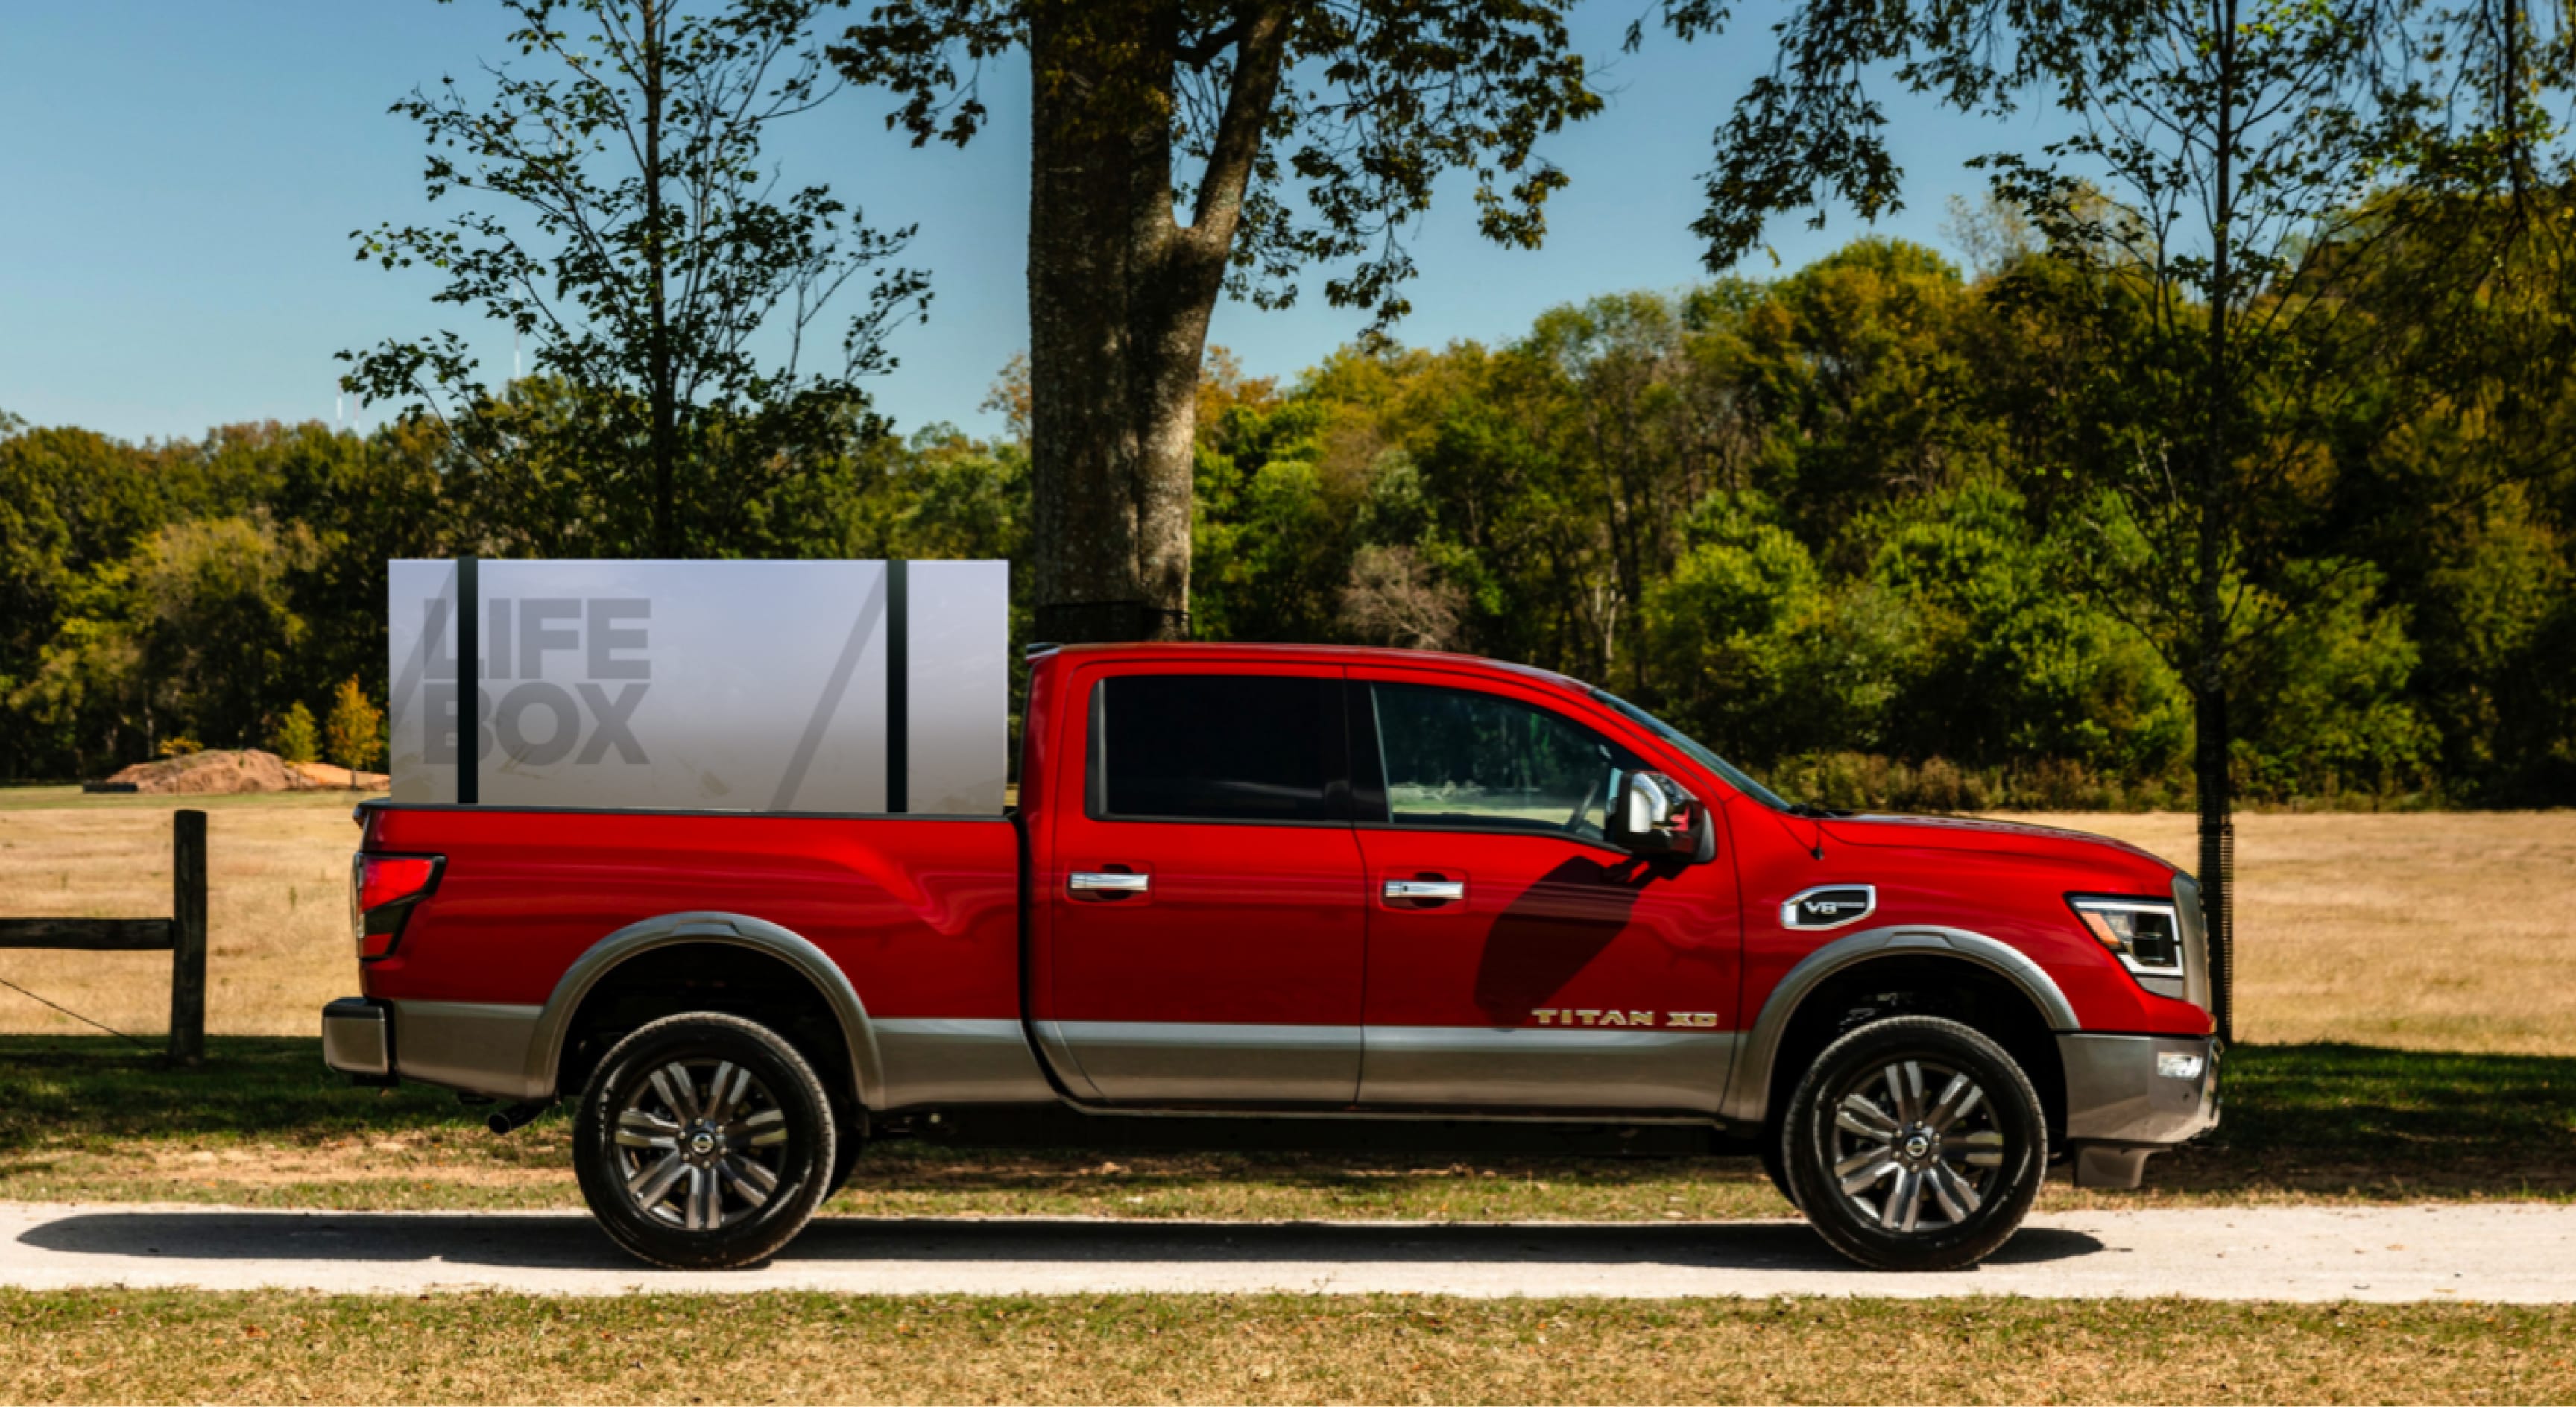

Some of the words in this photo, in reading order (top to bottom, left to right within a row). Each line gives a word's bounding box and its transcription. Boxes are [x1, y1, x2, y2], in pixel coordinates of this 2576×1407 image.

[423, 598, 651, 679] LIFE
[423, 682, 651, 766] BOX
[1804, 902, 1837, 914] V8
[1531, 1008, 1655, 1025] TITAN
[1665, 1011, 1718, 1028] XD
